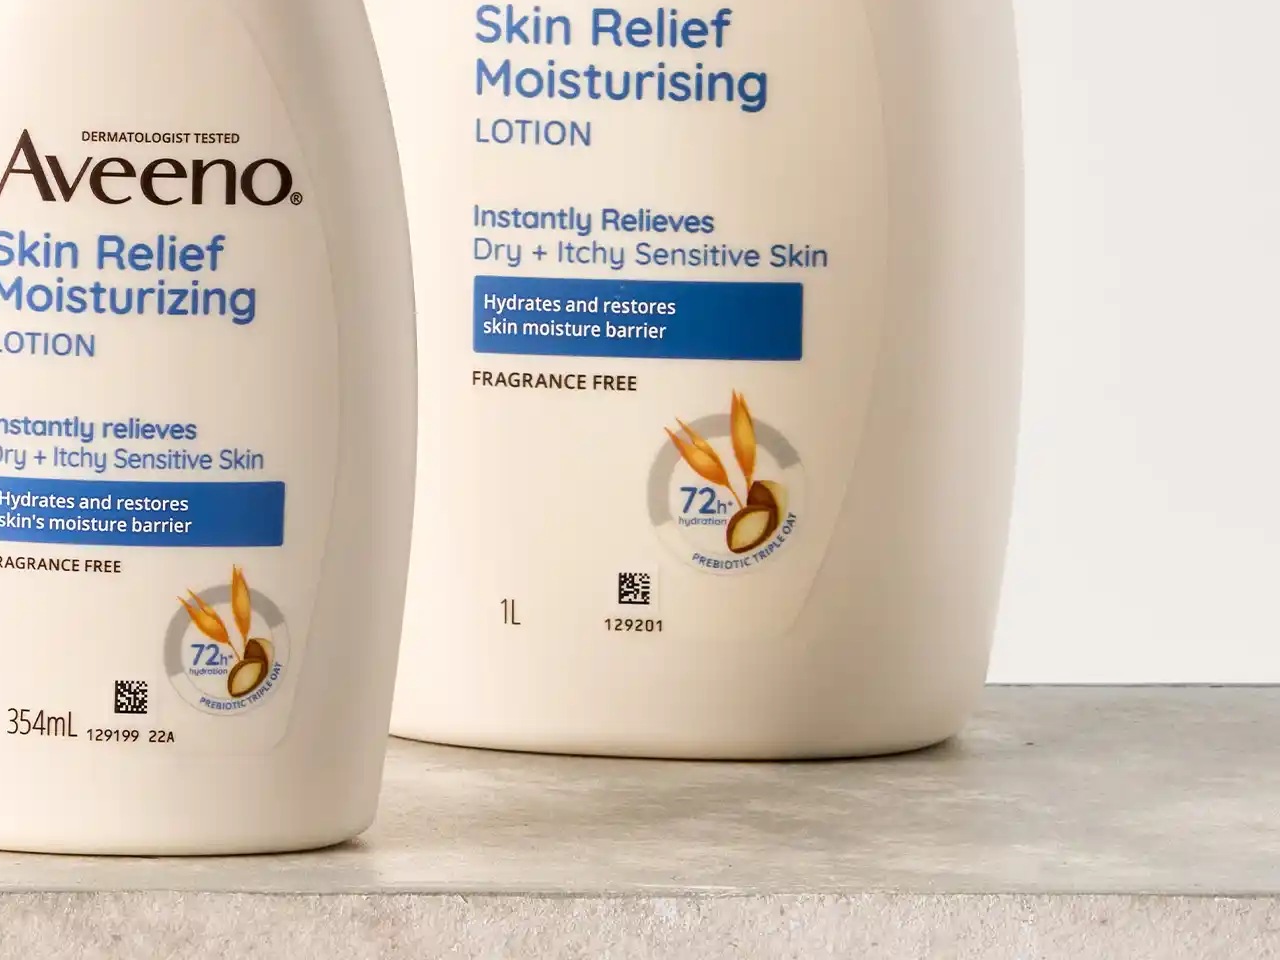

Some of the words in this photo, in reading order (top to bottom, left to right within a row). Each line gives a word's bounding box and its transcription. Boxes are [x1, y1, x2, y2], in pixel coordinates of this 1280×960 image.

[475, 4, 571, 45] Skin
[592, 8, 733, 49] Relief
[475, 58, 768, 113] Moisturising
[81, 131, 191, 144] DERMATOLOGIST
[194, 133, 240, 144] TESTED
[476, 118, 591, 146] LOTION
[473, 205, 592, 235] Instantly
[602, 208, 715, 233] Relieves
[97, 234, 226, 272] Relief
[474, 238, 521, 266] Dry
[532, 246, 548, 262] +
[557, 240, 625, 270] Itchy
[635, 243, 761, 267] Sensitive
[769, 244, 828, 268] Skin
[483, 293, 562, 315] Hydrates
[565, 296, 599, 313] and
[603, 299, 677, 315] restores
[483, 318, 519, 335] skin
[522, 320, 601, 338] moisture
[605, 322, 667, 339] barrier
[472, 371, 587, 390] FRAGRANCE
[592, 375, 638, 391] FREE
[102, 418, 197, 440] relieves
[34, 451, 47, 465] +
[53, 446, 107, 473] Itchy
[114, 448, 212, 471] Sensitive
[219, 449, 264, 470] Skin
[79, 493, 112, 511] and
[116, 496, 189, 512] restores
[49, 517, 127, 532] moisture
[132, 519, 192, 534] barrier
[678, 516, 727, 527] hydration
[692, 553, 753, 570] PREBIOTIC
[753, 534, 785, 561] TRIPLE
[782, 512, 797, 535] OAT
[84, 559, 122, 573] FREE
[500, 598, 521, 626] 1L
[604, 619, 664, 632] 129201
[189, 667, 228, 677] hydration
[200, 697, 246, 711] PREBIOTIC
[246, 681, 273, 704] TRIPLE
[270, 661, 283, 682] OAT
[7, 708, 78, 737] 354mL
[86, 728, 140, 743] 129199
[148, 730, 175, 743] 22A
